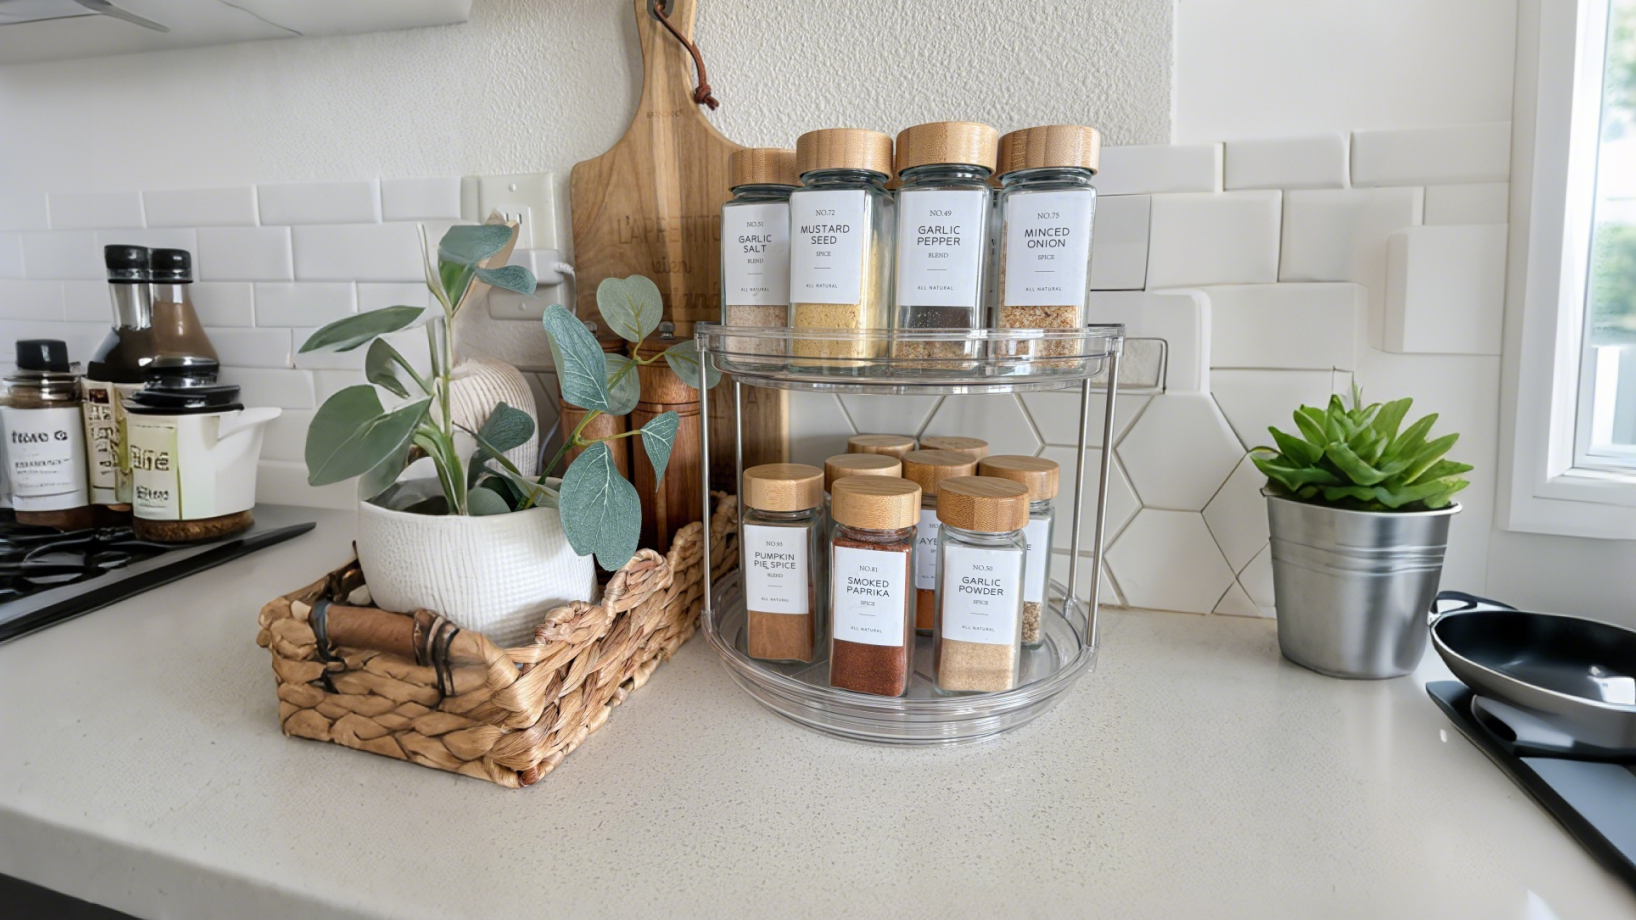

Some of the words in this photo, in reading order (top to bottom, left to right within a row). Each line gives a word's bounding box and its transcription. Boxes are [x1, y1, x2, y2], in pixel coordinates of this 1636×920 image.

[929, 209, 952, 217] NO.49
[1037, 212, 1060, 220] NO.75
[800, 224, 850, 234] MUSTARD
[918, 225, 960, 235] GARLIC
[1024, 227, 1070, 237] MINCED
[738, 234, 773, 244] GARLIC
[811, 235, 837, 245] SEED
[917, 236, 961, 246] PEPPER
[1027, 239, 1066, 249] ONION
[743, 244, 767, 253] SALT
[754, 551, 795, 561] PUMPKIN
[754, 560, 768, 569] PIE
[847, 576, 890, 588] SMOKED
[961, 576, 1001, 587] GARLIC
[846, 586, 890, 597] PAPRIKA
[958, 585, 1004, 596] POWDER
